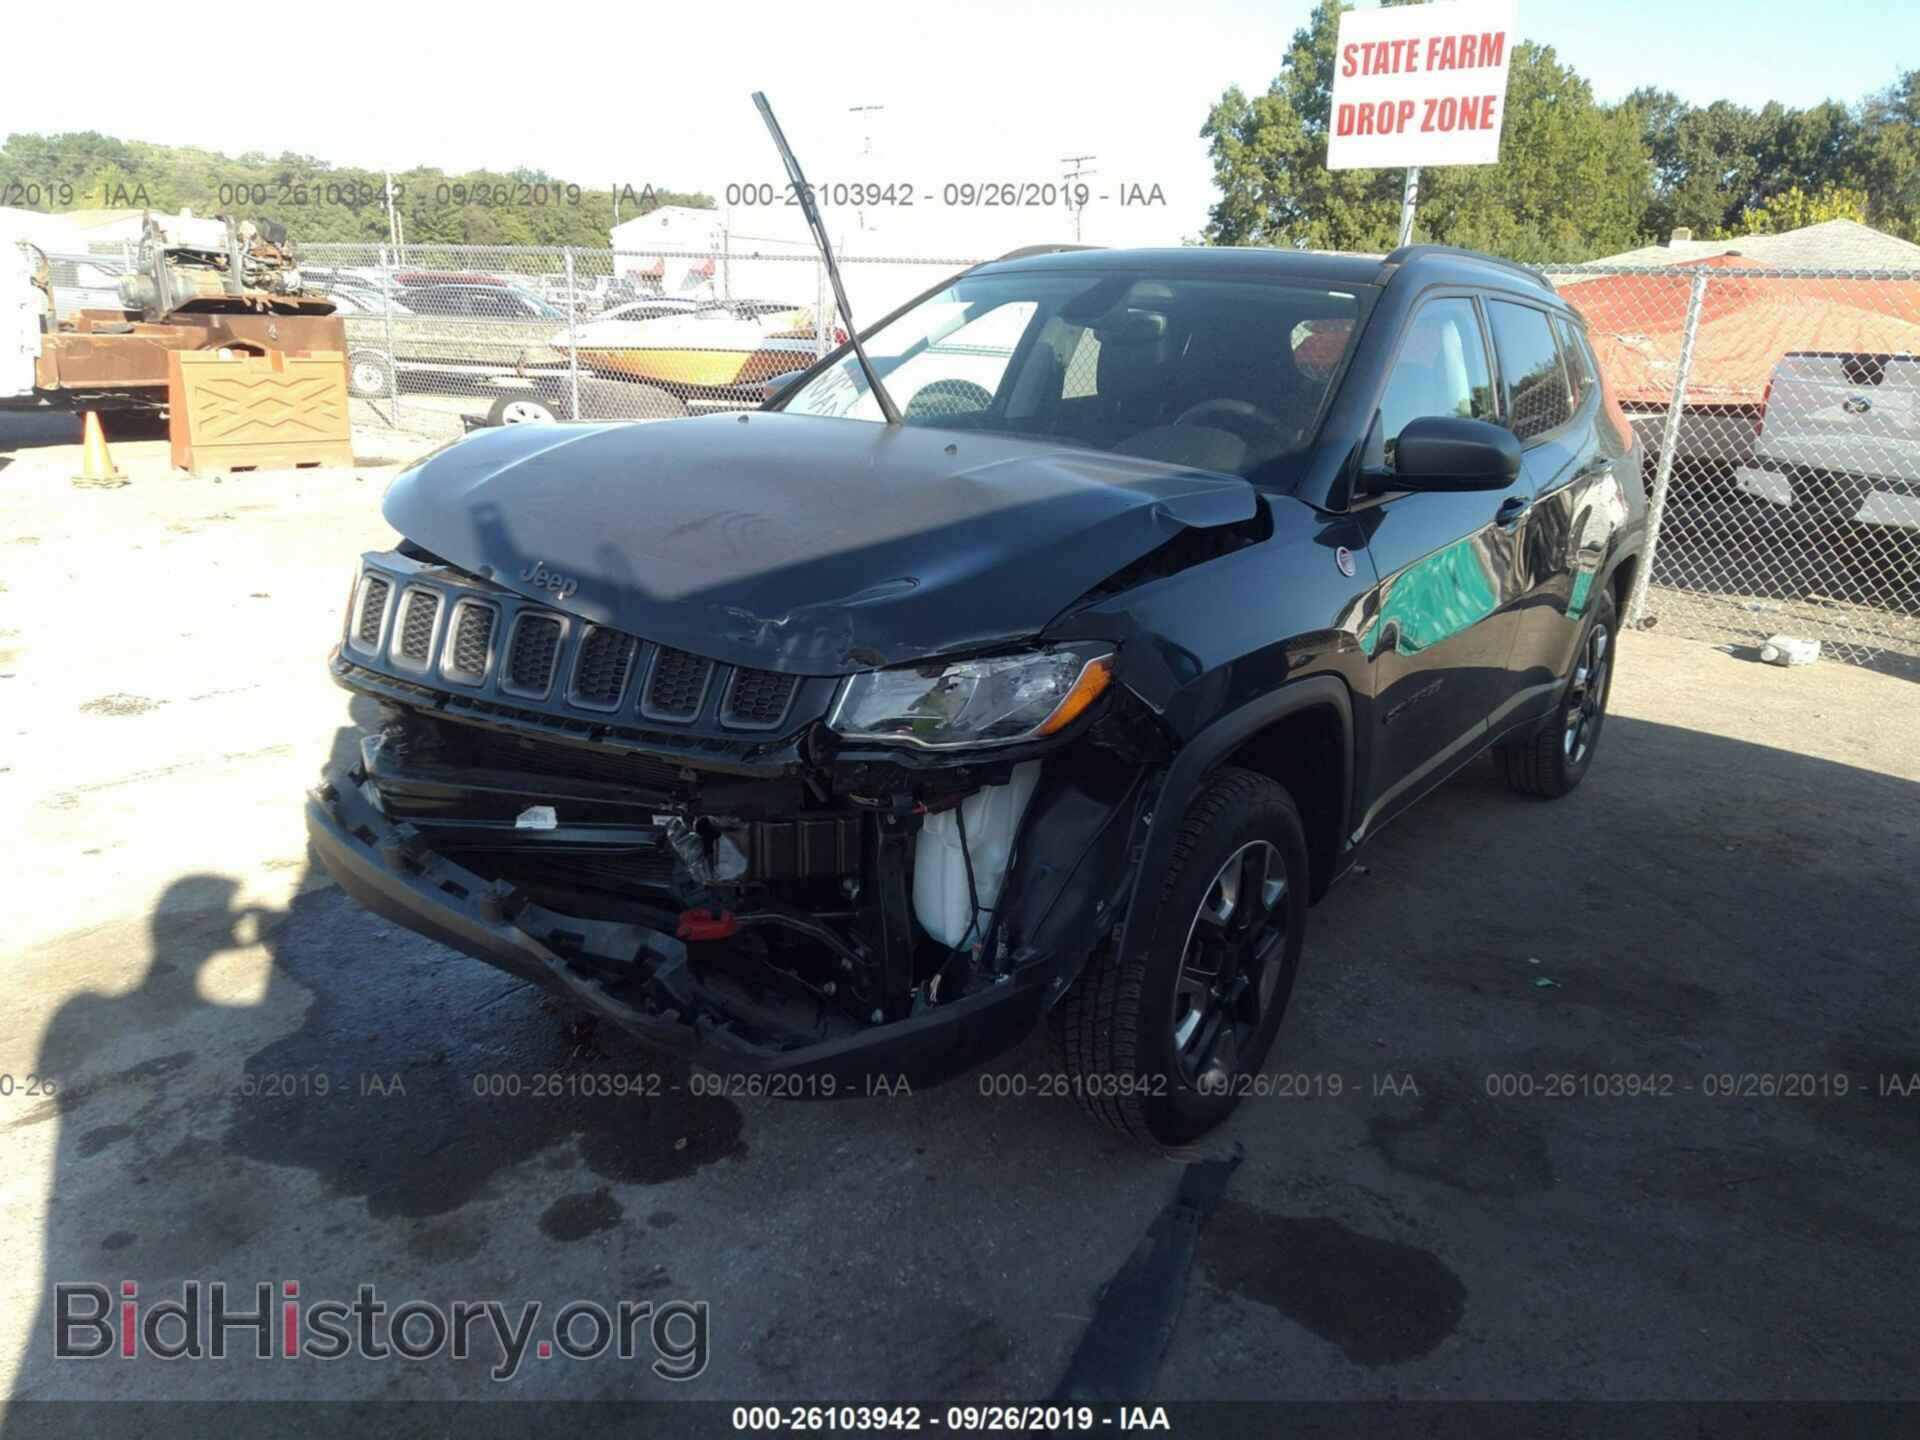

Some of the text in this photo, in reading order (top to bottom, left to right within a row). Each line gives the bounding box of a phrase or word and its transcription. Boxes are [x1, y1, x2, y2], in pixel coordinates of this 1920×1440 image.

[1342, 31, 1504, 77] STATE FARM
[1337, 95, 1496, 137] DROP ZONE
[520, 560, 577, 600] Jeep
